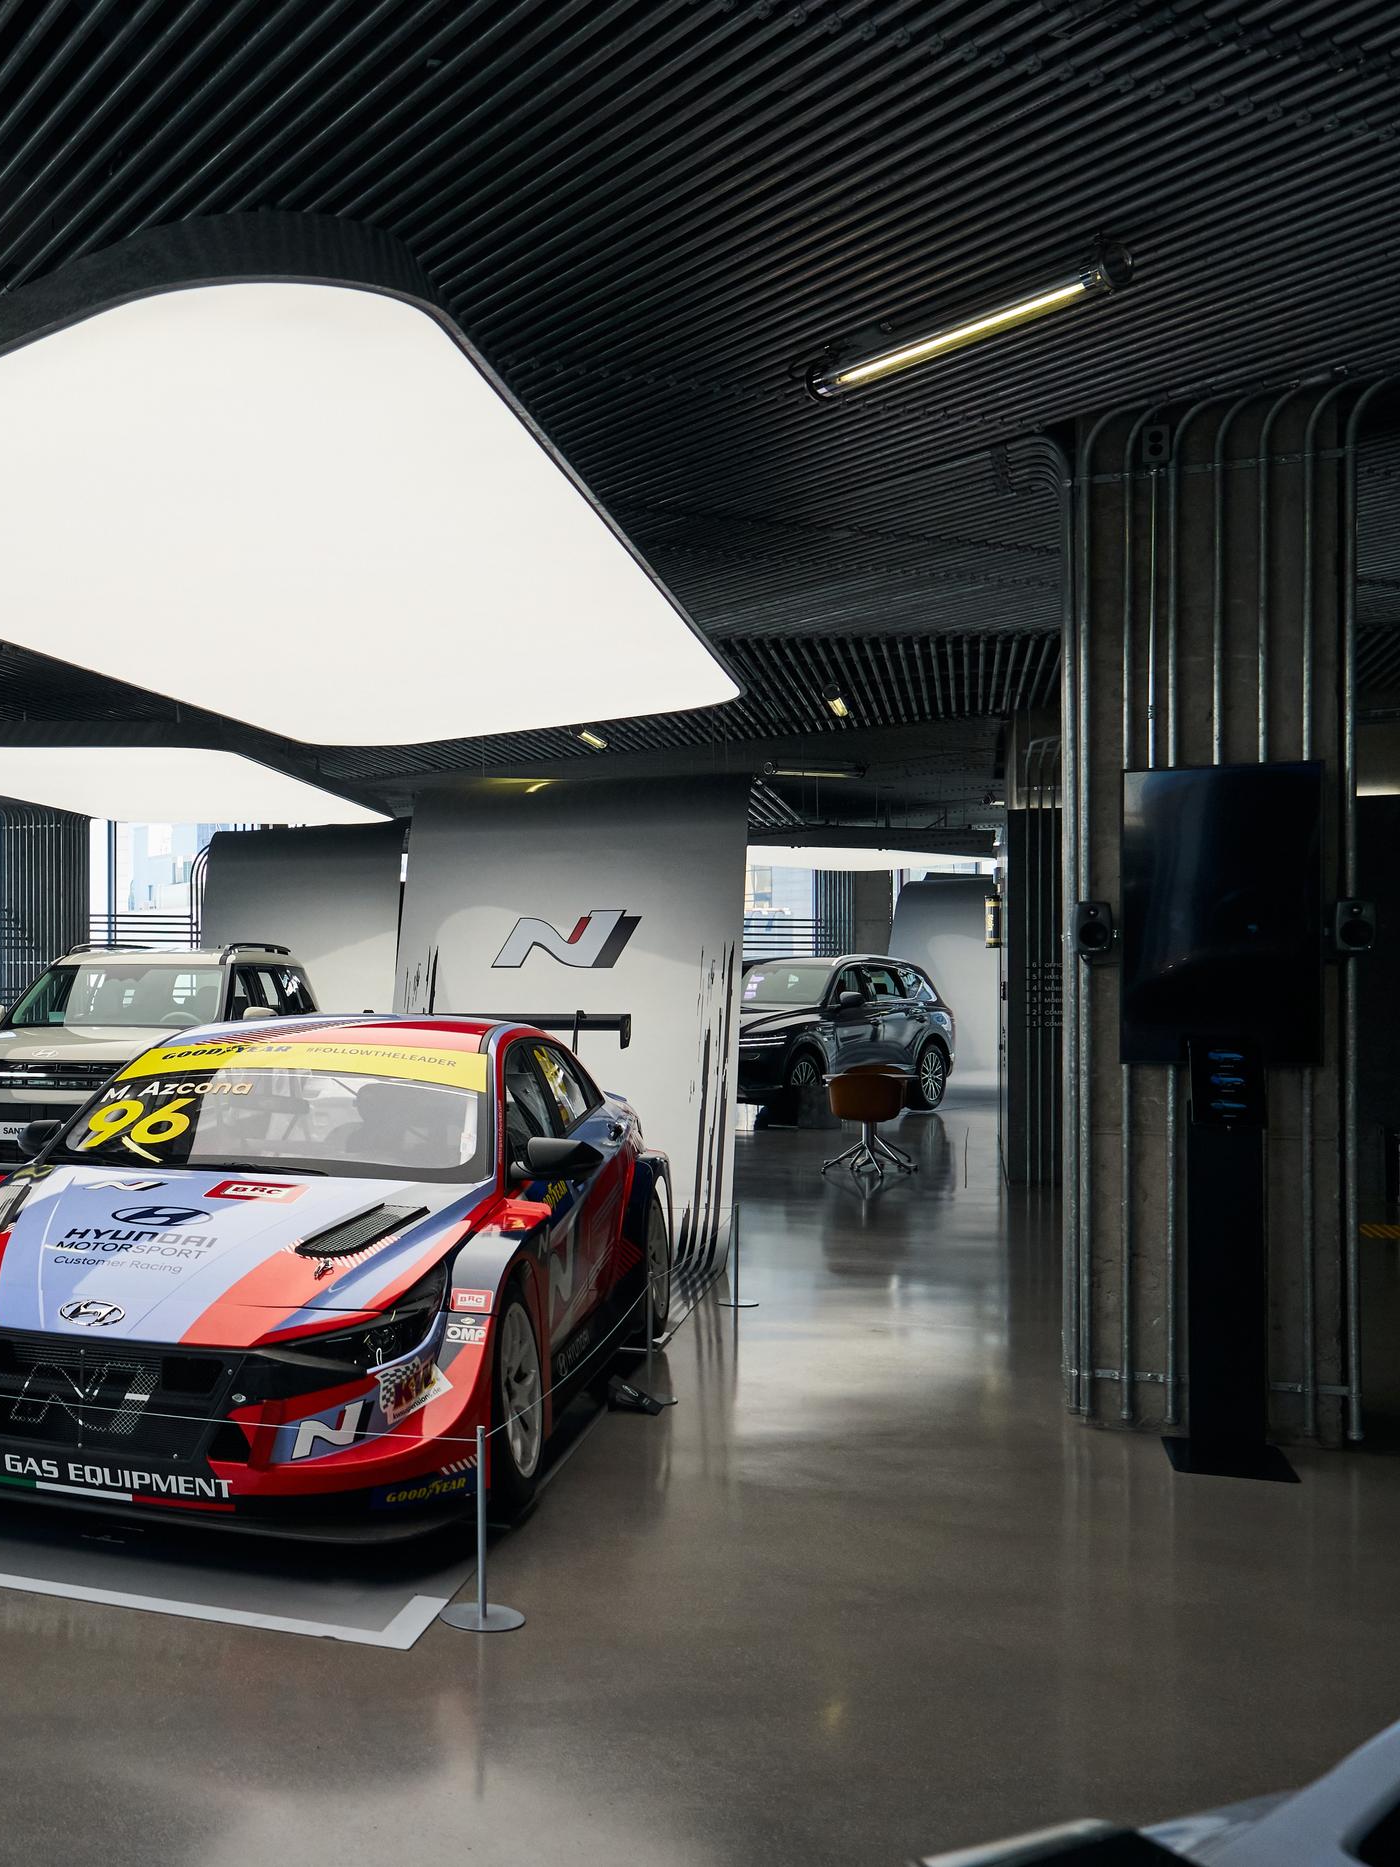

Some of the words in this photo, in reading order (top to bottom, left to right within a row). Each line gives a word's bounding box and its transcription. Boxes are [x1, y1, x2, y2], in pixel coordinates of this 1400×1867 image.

[162, 1044, 293, 1060] GOODYEAR
[306, 1046, 458, 1069] #FOLLOWTHELEADER
[100, 1086, 131, 1103] M.
[138, 1080, 255, 1097] Azcona
[79, 1098, 197, 1148] 96
[231, 1186, 283, 1195] BRC
[64, 1228, 218, 1248] HYUNDAI
[55, 1240, 209, 1260] MOTORSPORT
[53, 1255, 125, 1269] Customer
[131, 1260, 183, 1275] Racing
[459, 1295, 483, 1305] BRC
[447, 1327, 486, 1341] OMP
[4, 1453, 59, 1478] GAS
[67, 1462, 233, 1498] EQUIPMENT
[385, 1477, 466, 1503] GOODYEAR
